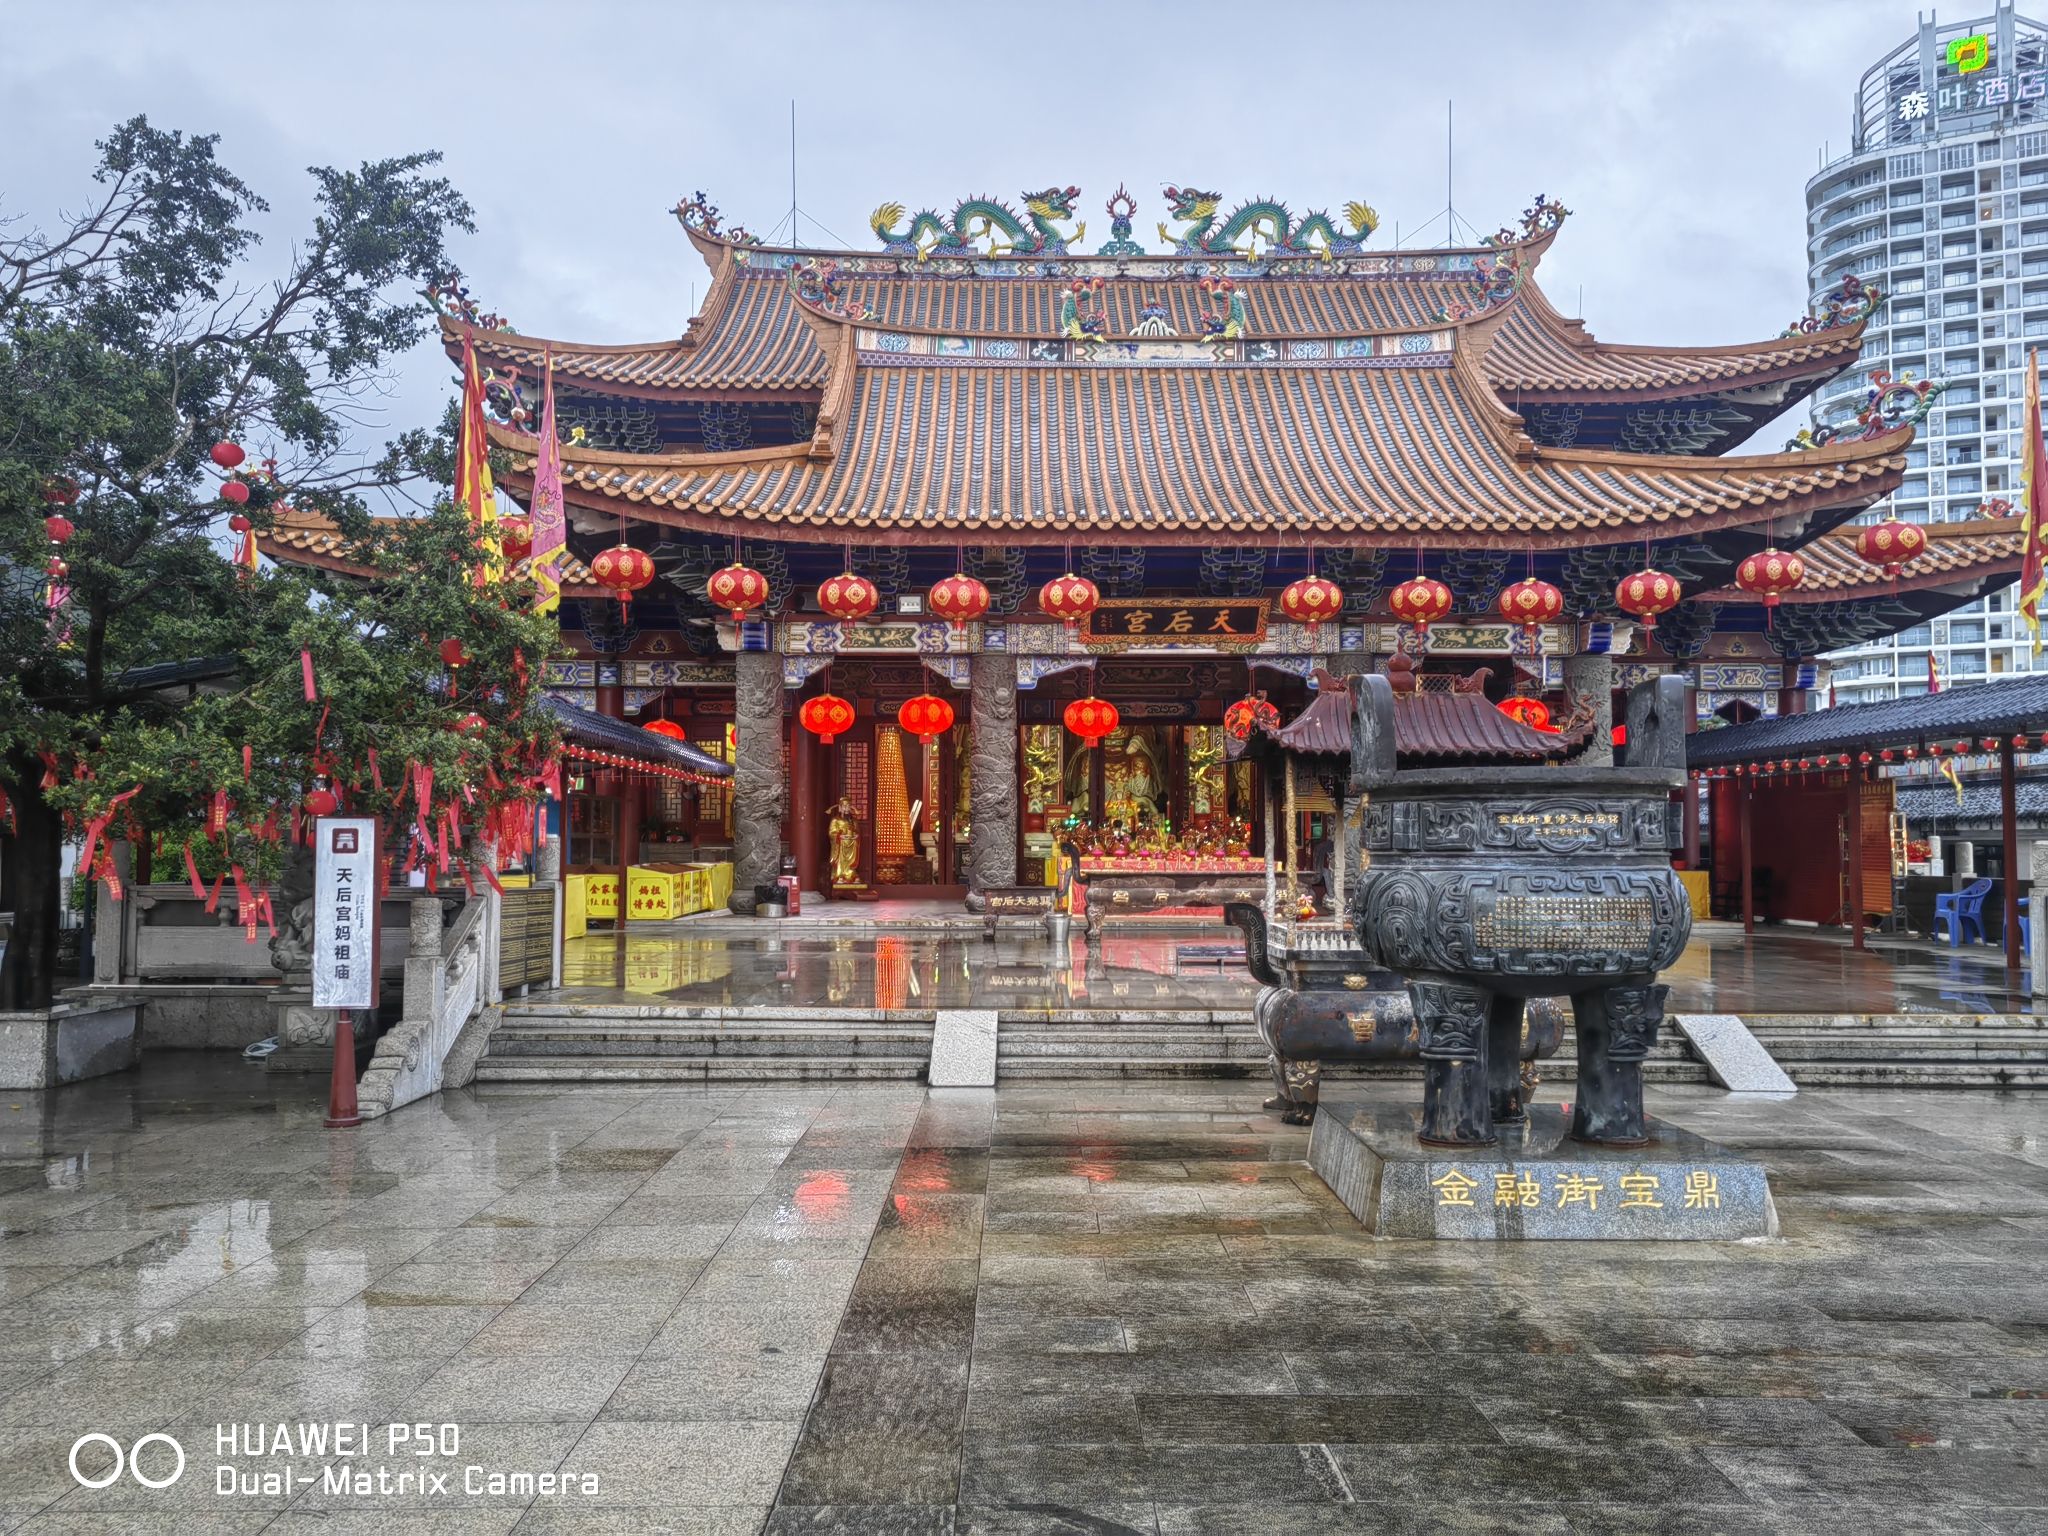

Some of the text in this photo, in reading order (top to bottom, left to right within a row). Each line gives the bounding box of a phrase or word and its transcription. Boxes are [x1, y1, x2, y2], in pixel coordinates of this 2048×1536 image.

[1898, 69, 2047, 121] 森叶酒店
[334, 868, 353, 980] 天后宫妈祖庙
[1431, 1168, 1721, 1211] 金融街宝鼎
